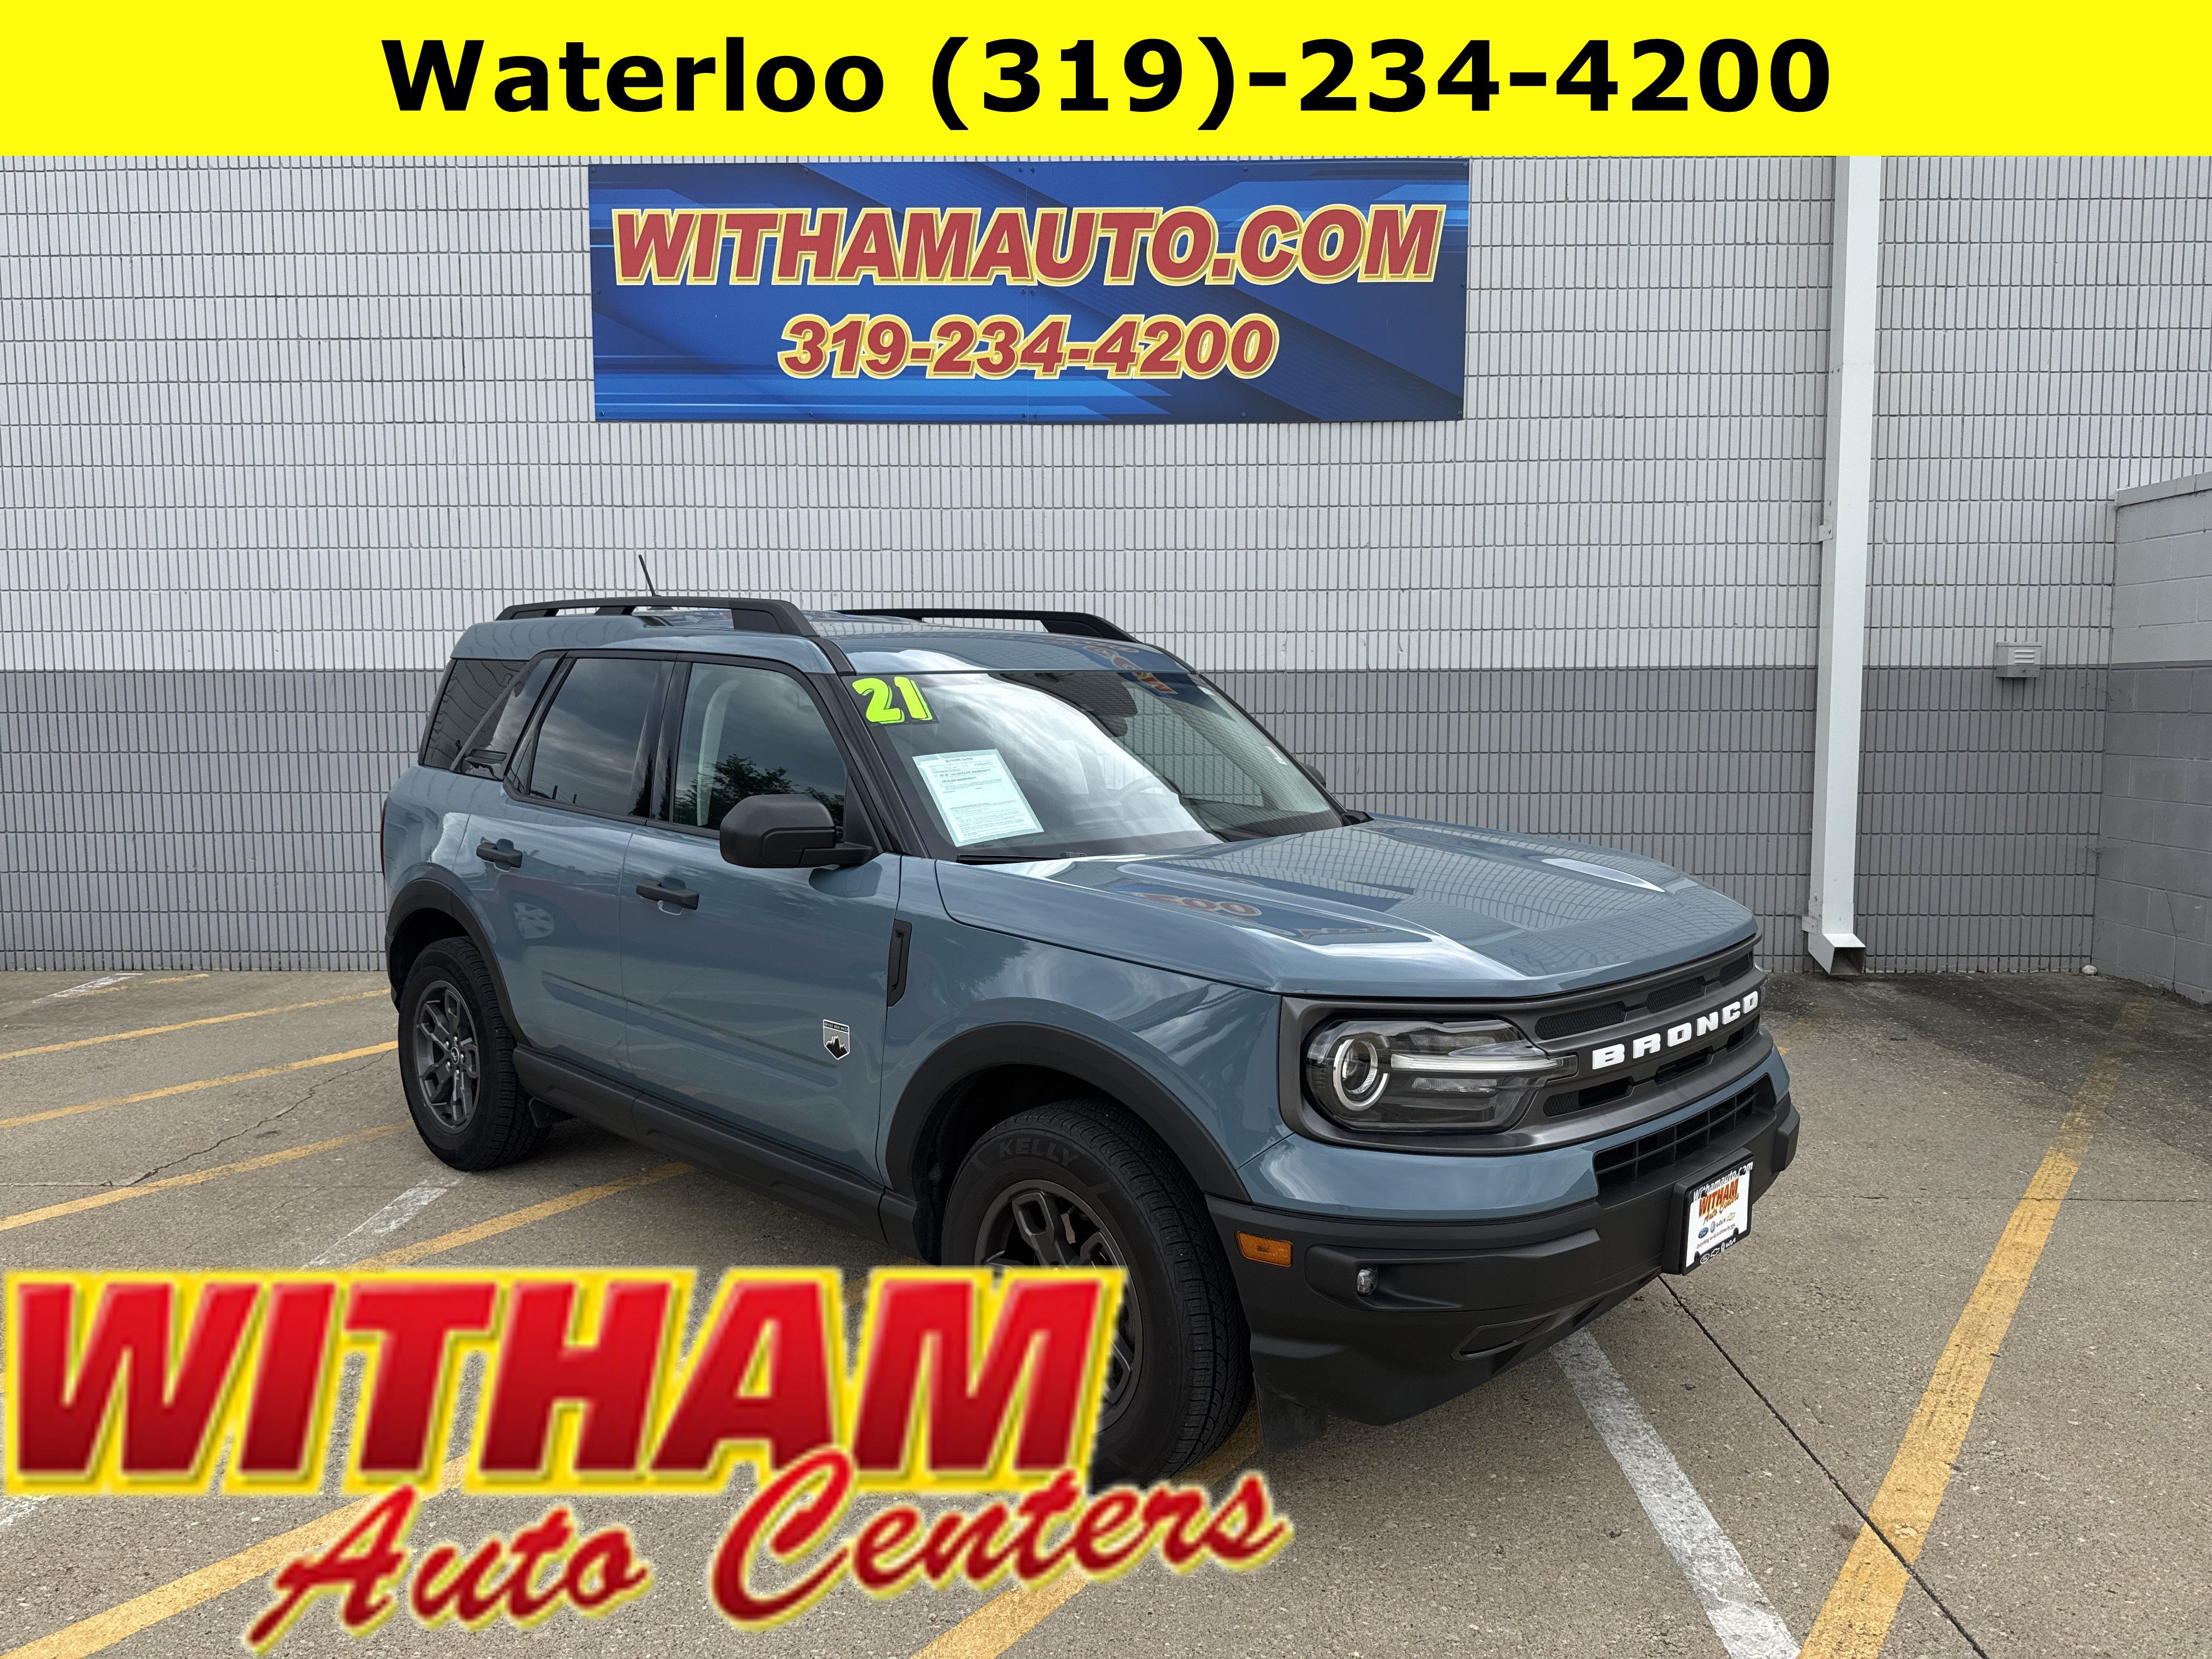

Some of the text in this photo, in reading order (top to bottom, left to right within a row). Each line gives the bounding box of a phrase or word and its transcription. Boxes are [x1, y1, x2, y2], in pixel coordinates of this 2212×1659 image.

[612, 204, 1446, 286] WITHAMAUTO.COM
[777, 313, 1279, 379] 319-234-4200
[852, 676, 933, 724] 21
[1592, 991, 1758, 1070] BRONCO
[999, 1137, 1079, 1167] KELLY
[1699, 1178, 1739, 1218] WITHAM
